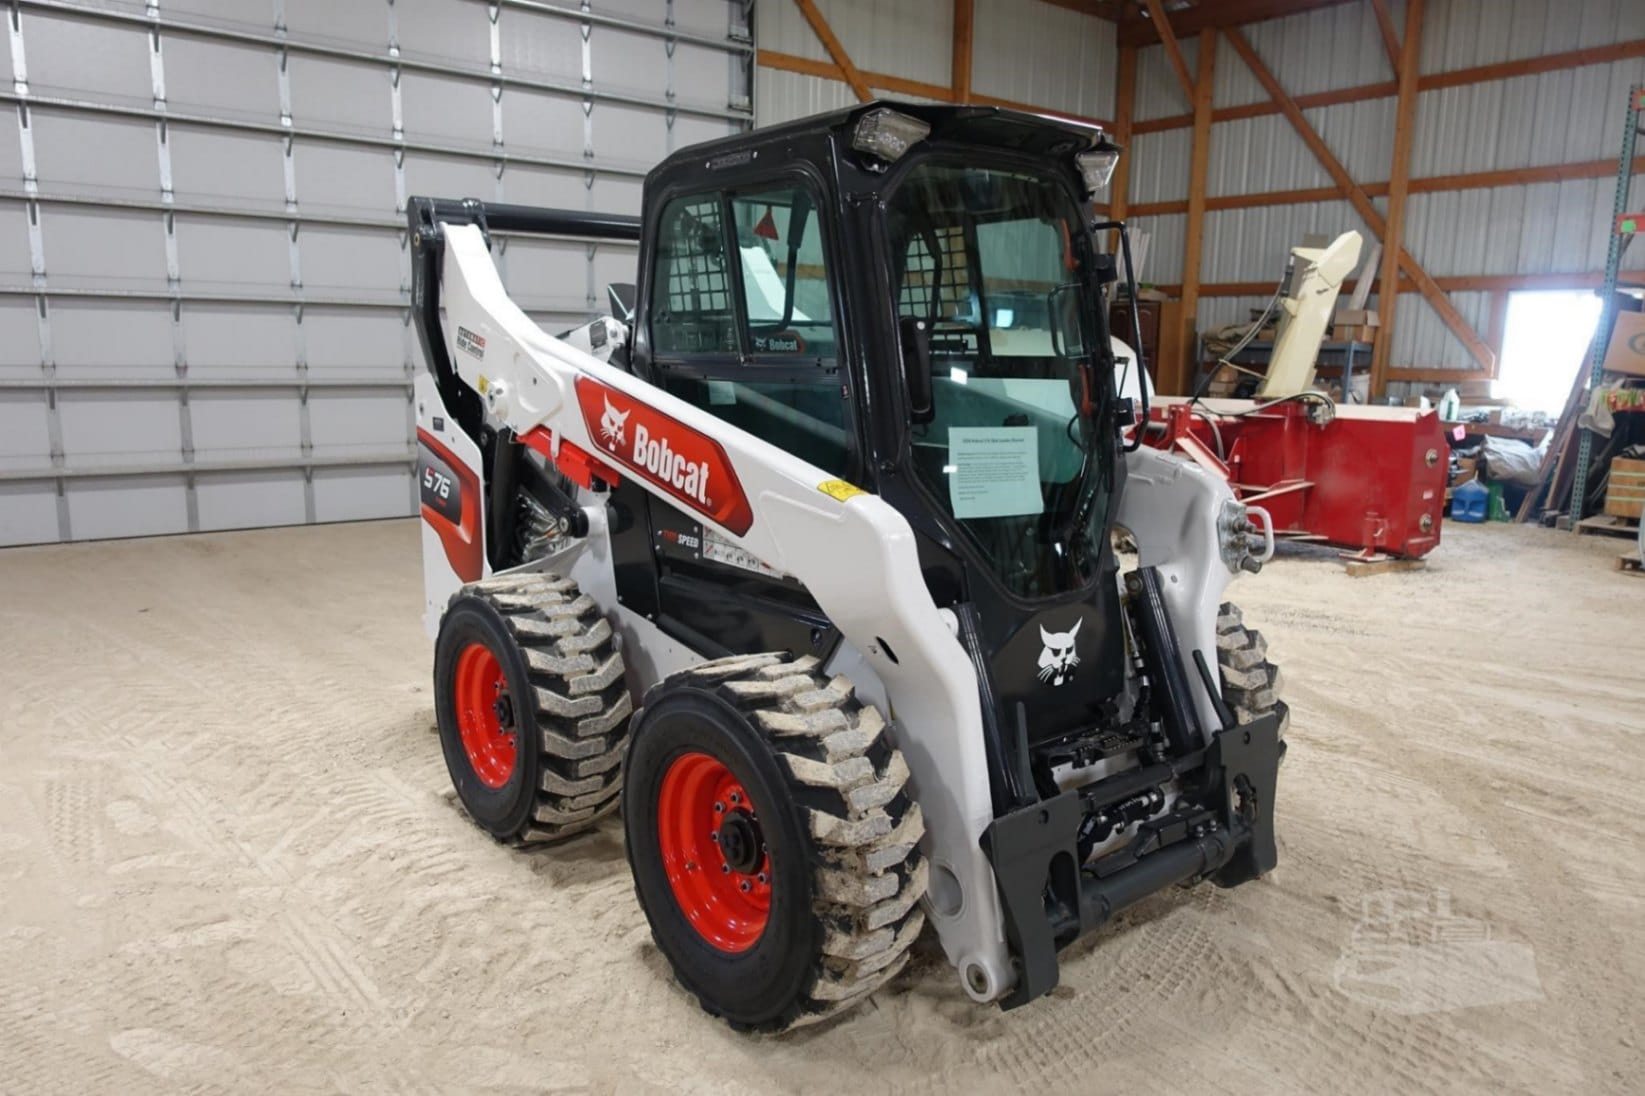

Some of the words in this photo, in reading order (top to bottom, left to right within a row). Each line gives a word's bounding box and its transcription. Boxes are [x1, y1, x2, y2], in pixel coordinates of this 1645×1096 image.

[769, 338, 798, 351] Bobcat
[633, 423, 709, 505] Bobcat
[424, 466, 451, 499] S76
[678, 534, 699, 548] SPEED
